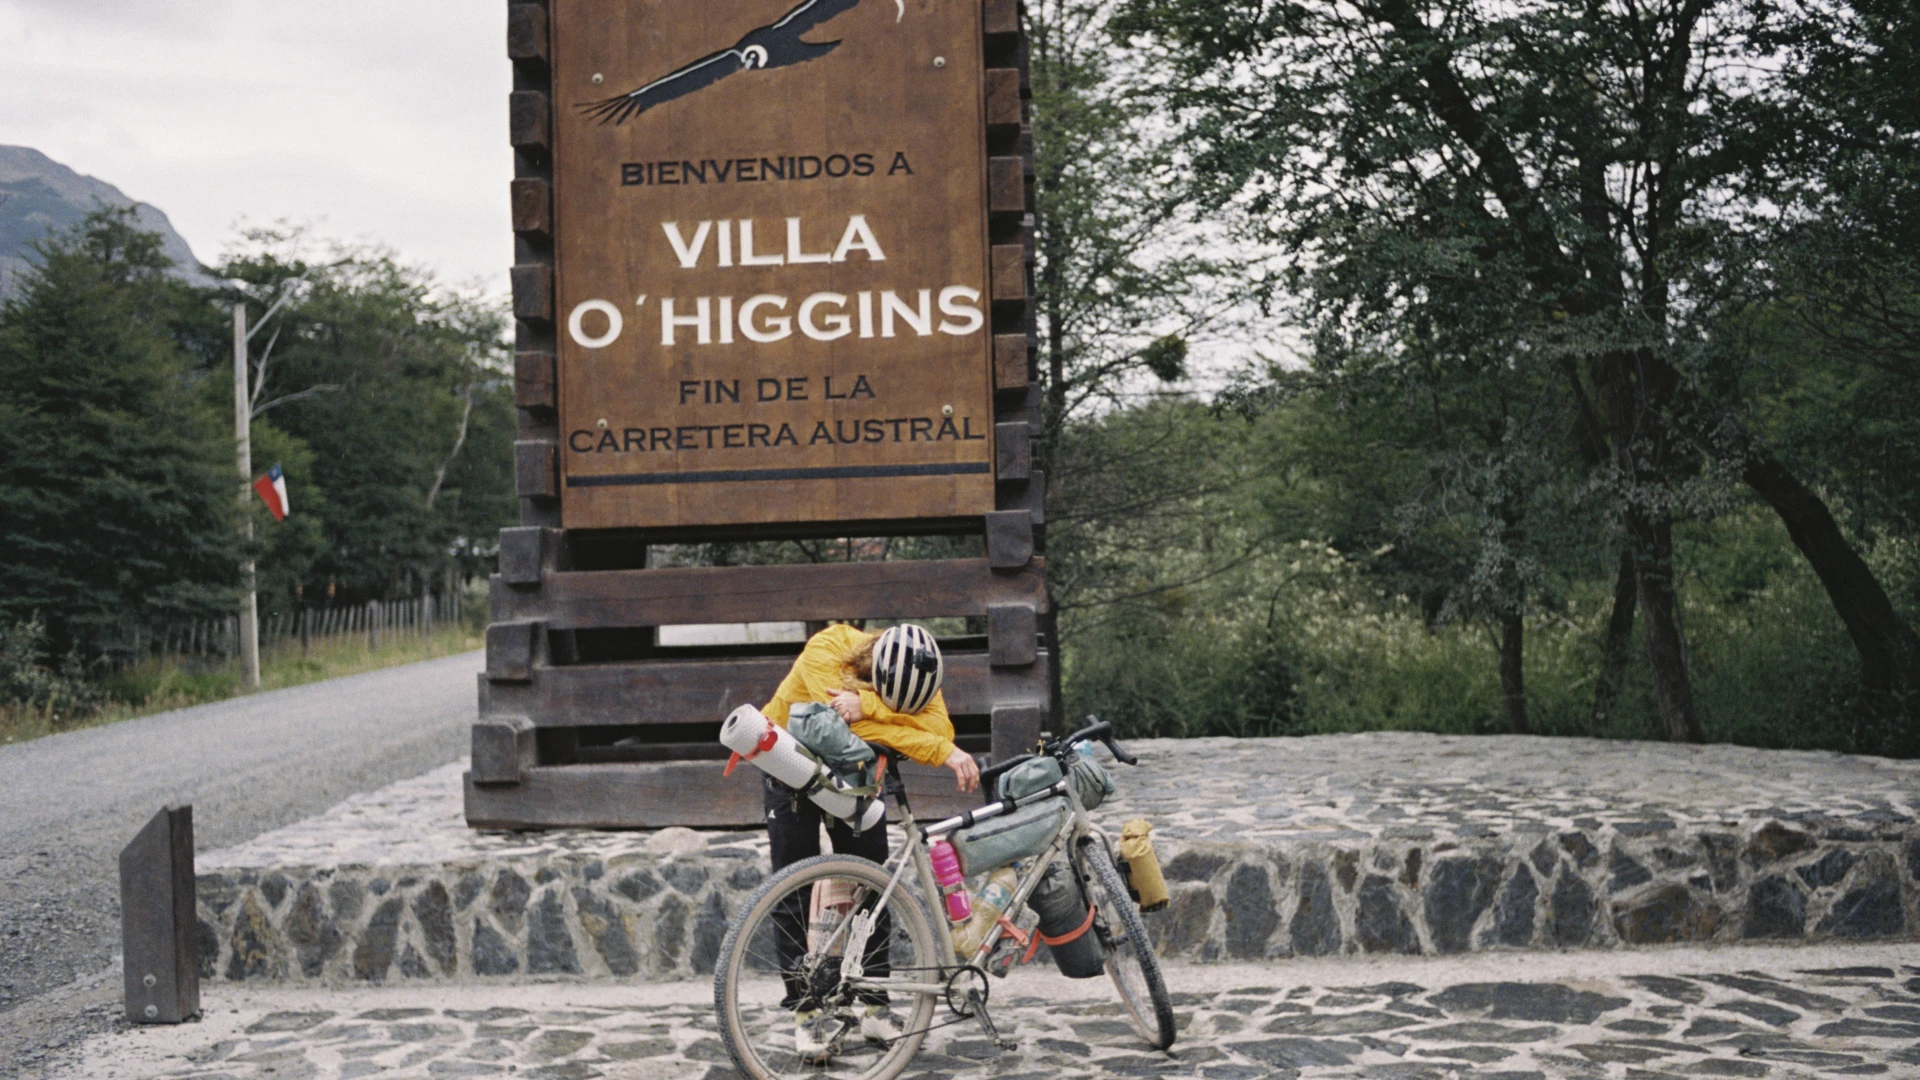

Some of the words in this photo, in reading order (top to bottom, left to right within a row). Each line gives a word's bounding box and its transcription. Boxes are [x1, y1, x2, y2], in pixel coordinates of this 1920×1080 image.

[621, 153, 875, 187] BIENVENIDOS
[887, 151, 915, 176] A
[661, 214, 886, 268] VILLA
[679, 379, 740, 404] FIN
[757, 377, 808, 402] DE
[824, 375, 876, 400] LA
[568, 422, 799, 453] CARRETERA
[808, 416, 986, 445] AUSTRAL
